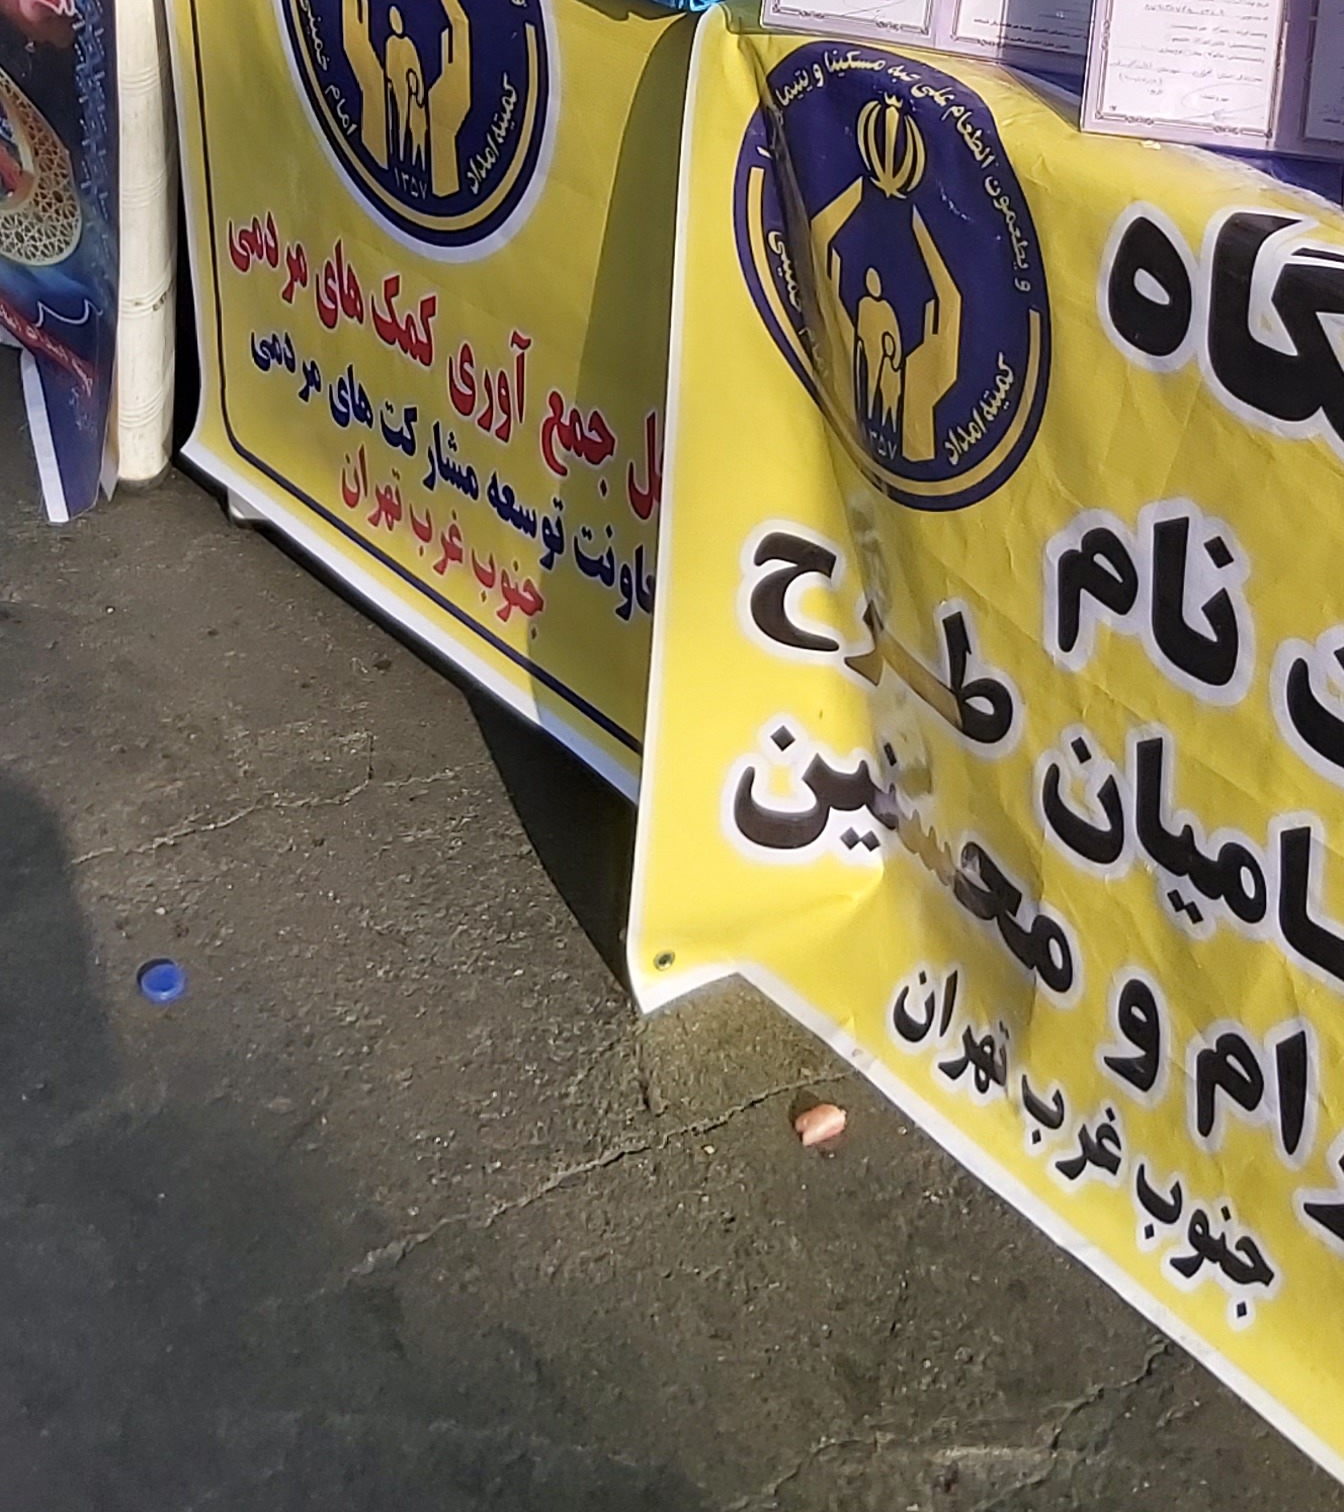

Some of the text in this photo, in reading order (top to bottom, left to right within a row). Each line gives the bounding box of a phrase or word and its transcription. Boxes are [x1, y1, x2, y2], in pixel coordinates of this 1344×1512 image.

[227, 209, 308, 304] مردمی
[315, 238, 364, 329] های
[250, 328, 322, 403] مردمی
[370, 273, 437, 368] کمک
[328, 362, 375, 431] های
[448, 329, 532, 443] آوری
[379, 398, 480, 504] مشارکت
[540, 390, 616, 499] جمع
[340, 444, 545, 639] جنوب غرب تهران
[486, 469, 567, 571] توسعه
[750, 531, 1015, 745] طرح
[1059, 516, 1243, 689] نام
[1105, 978, 1163, 1090] و
[893, 969, 1279, 1318] جنوب غرب تهران
